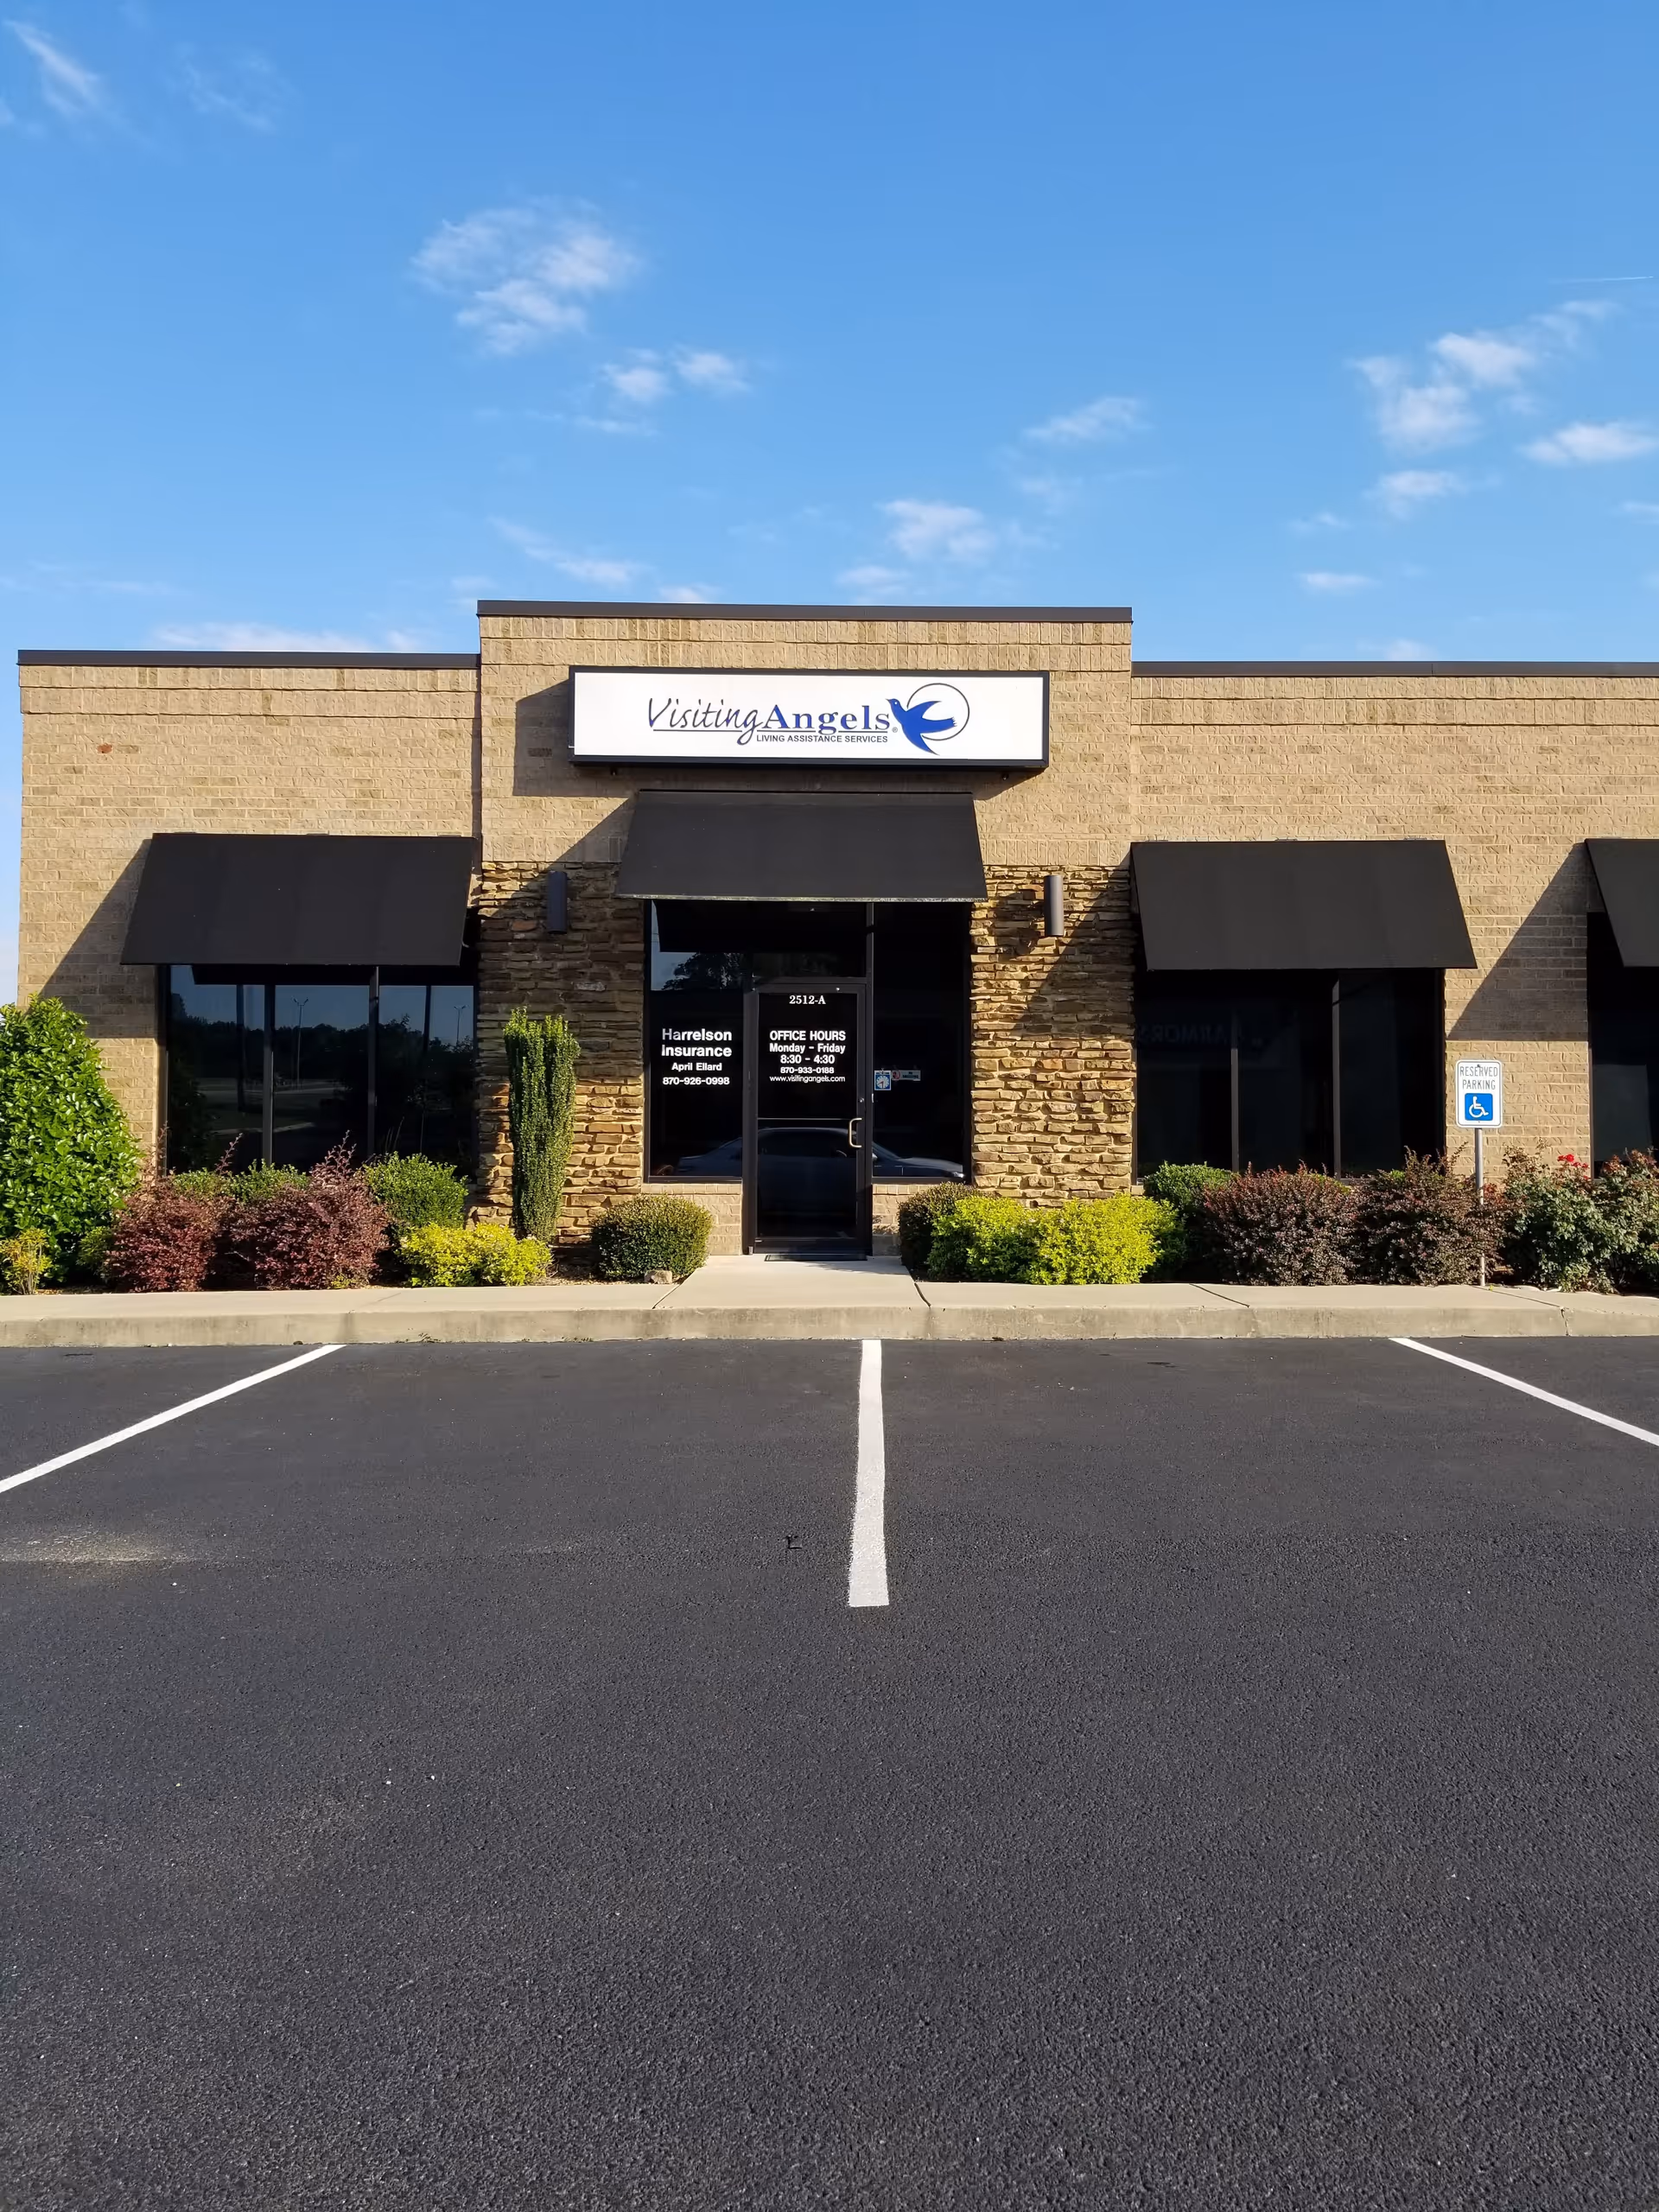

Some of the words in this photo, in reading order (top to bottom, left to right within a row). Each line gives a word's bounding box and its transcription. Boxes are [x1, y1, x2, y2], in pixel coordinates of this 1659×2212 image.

[648, 697, 763, 746] Visiting
[761, 704, 890, 735] Angels
[787, 734, 842, 743] ASSISTANCE
[789, 995, 826, 1004] 2512-A
[662, 1028, 733, 1041] Harrelson
[769, 1030, 806, 1041] OFFICE
[810, 1030, 846, 1041] HOURS
[661, 1044, 733, 1057] Insurance
[769, 1043, 805, 1054] Monday
[817, 1043, 846, 1054] Friday
[780, 1054, 802, 1064] 8:30
[813, 1054, 836, 1064] 4:30
[671, 1062, 693, 1071] April
[696, 1062, 722, 1071] Ellard
[1460, 1065, 1498, 1077] RESERVED
[662, 1077, 730, 1085] 870-926-0998
[769, 1074, 846, 1084] www.visitingangels.com
[1462, 1079, 1496, 1090] PARKING
